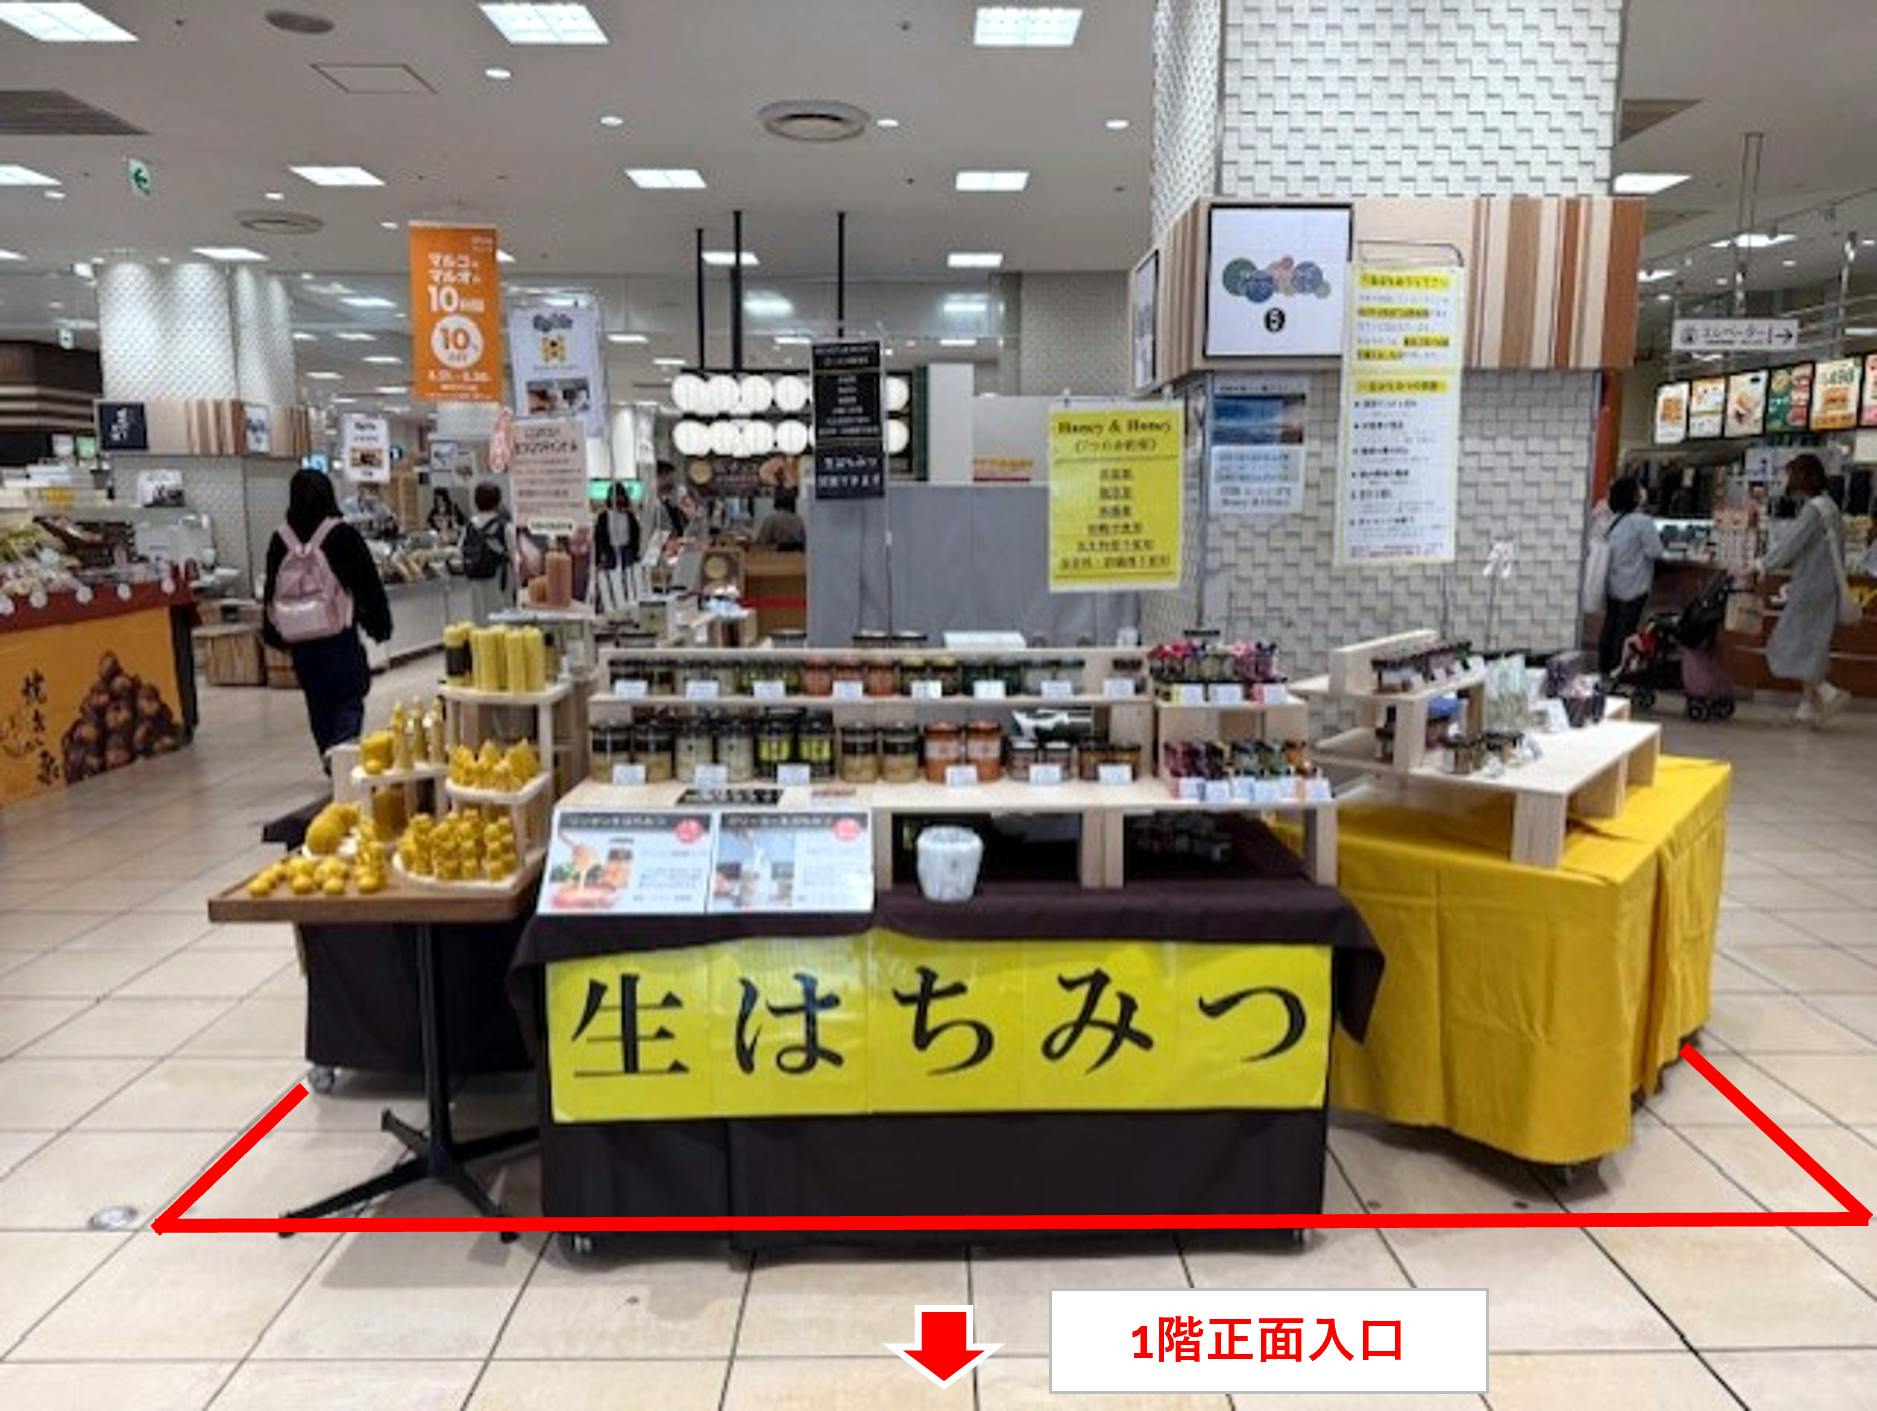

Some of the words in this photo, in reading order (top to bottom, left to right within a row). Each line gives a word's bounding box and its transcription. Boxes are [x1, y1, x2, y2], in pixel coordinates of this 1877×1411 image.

[1108, 420, 1122, 432] &
[571, 966, 1308, 1076] 生はちみつ
